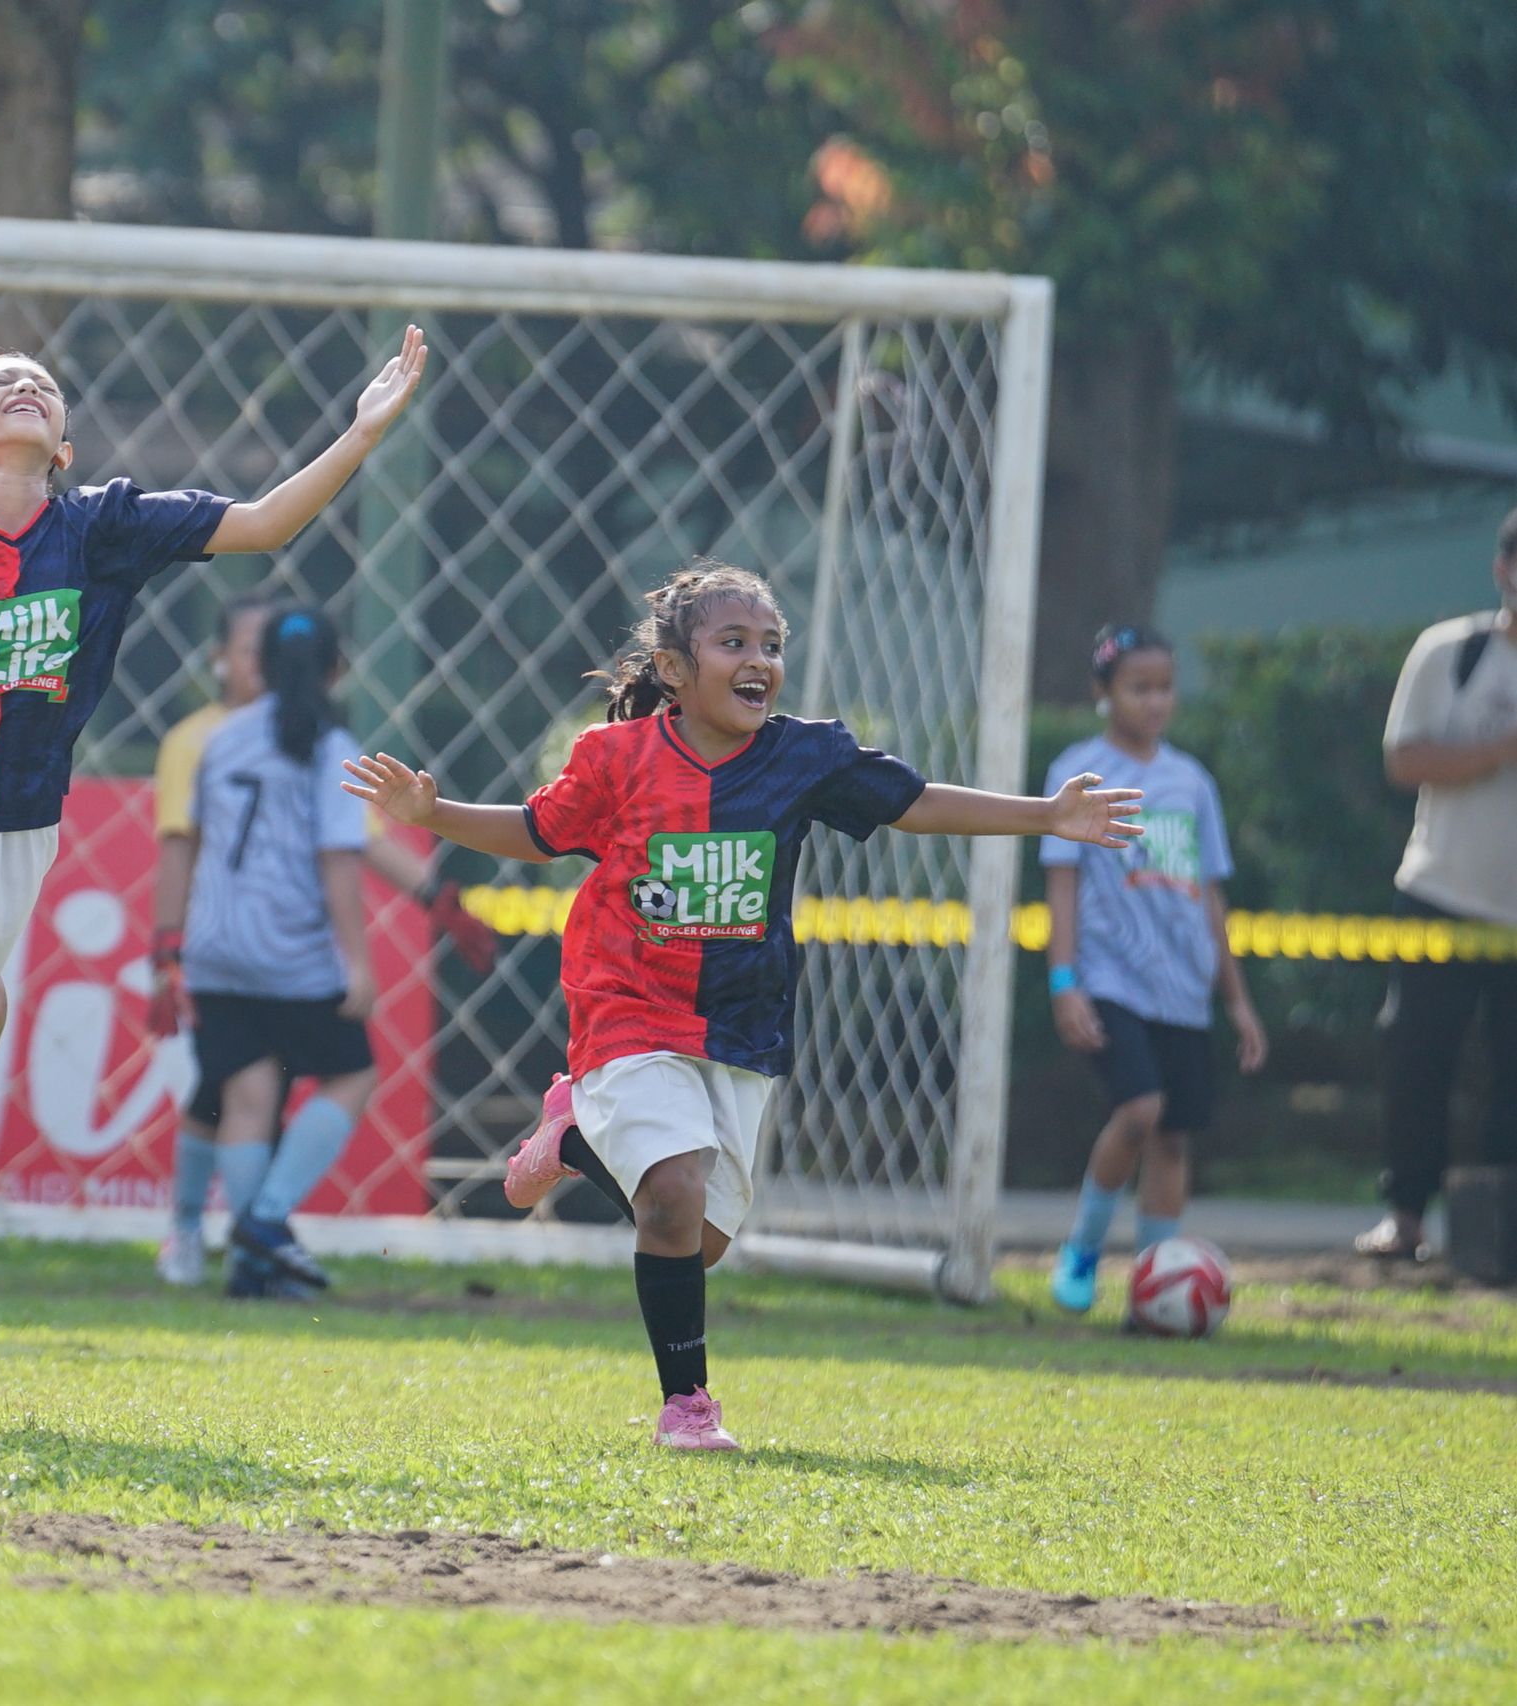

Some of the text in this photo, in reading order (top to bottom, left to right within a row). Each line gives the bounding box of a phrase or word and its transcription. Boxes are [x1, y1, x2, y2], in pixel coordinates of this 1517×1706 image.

[230, 773, 262, 871] 7
[662, 839, 764, 885] Milk
[677, 882, 764, 924] Life
[657, 925, 759, 937] SOCCER CHALLENGE
